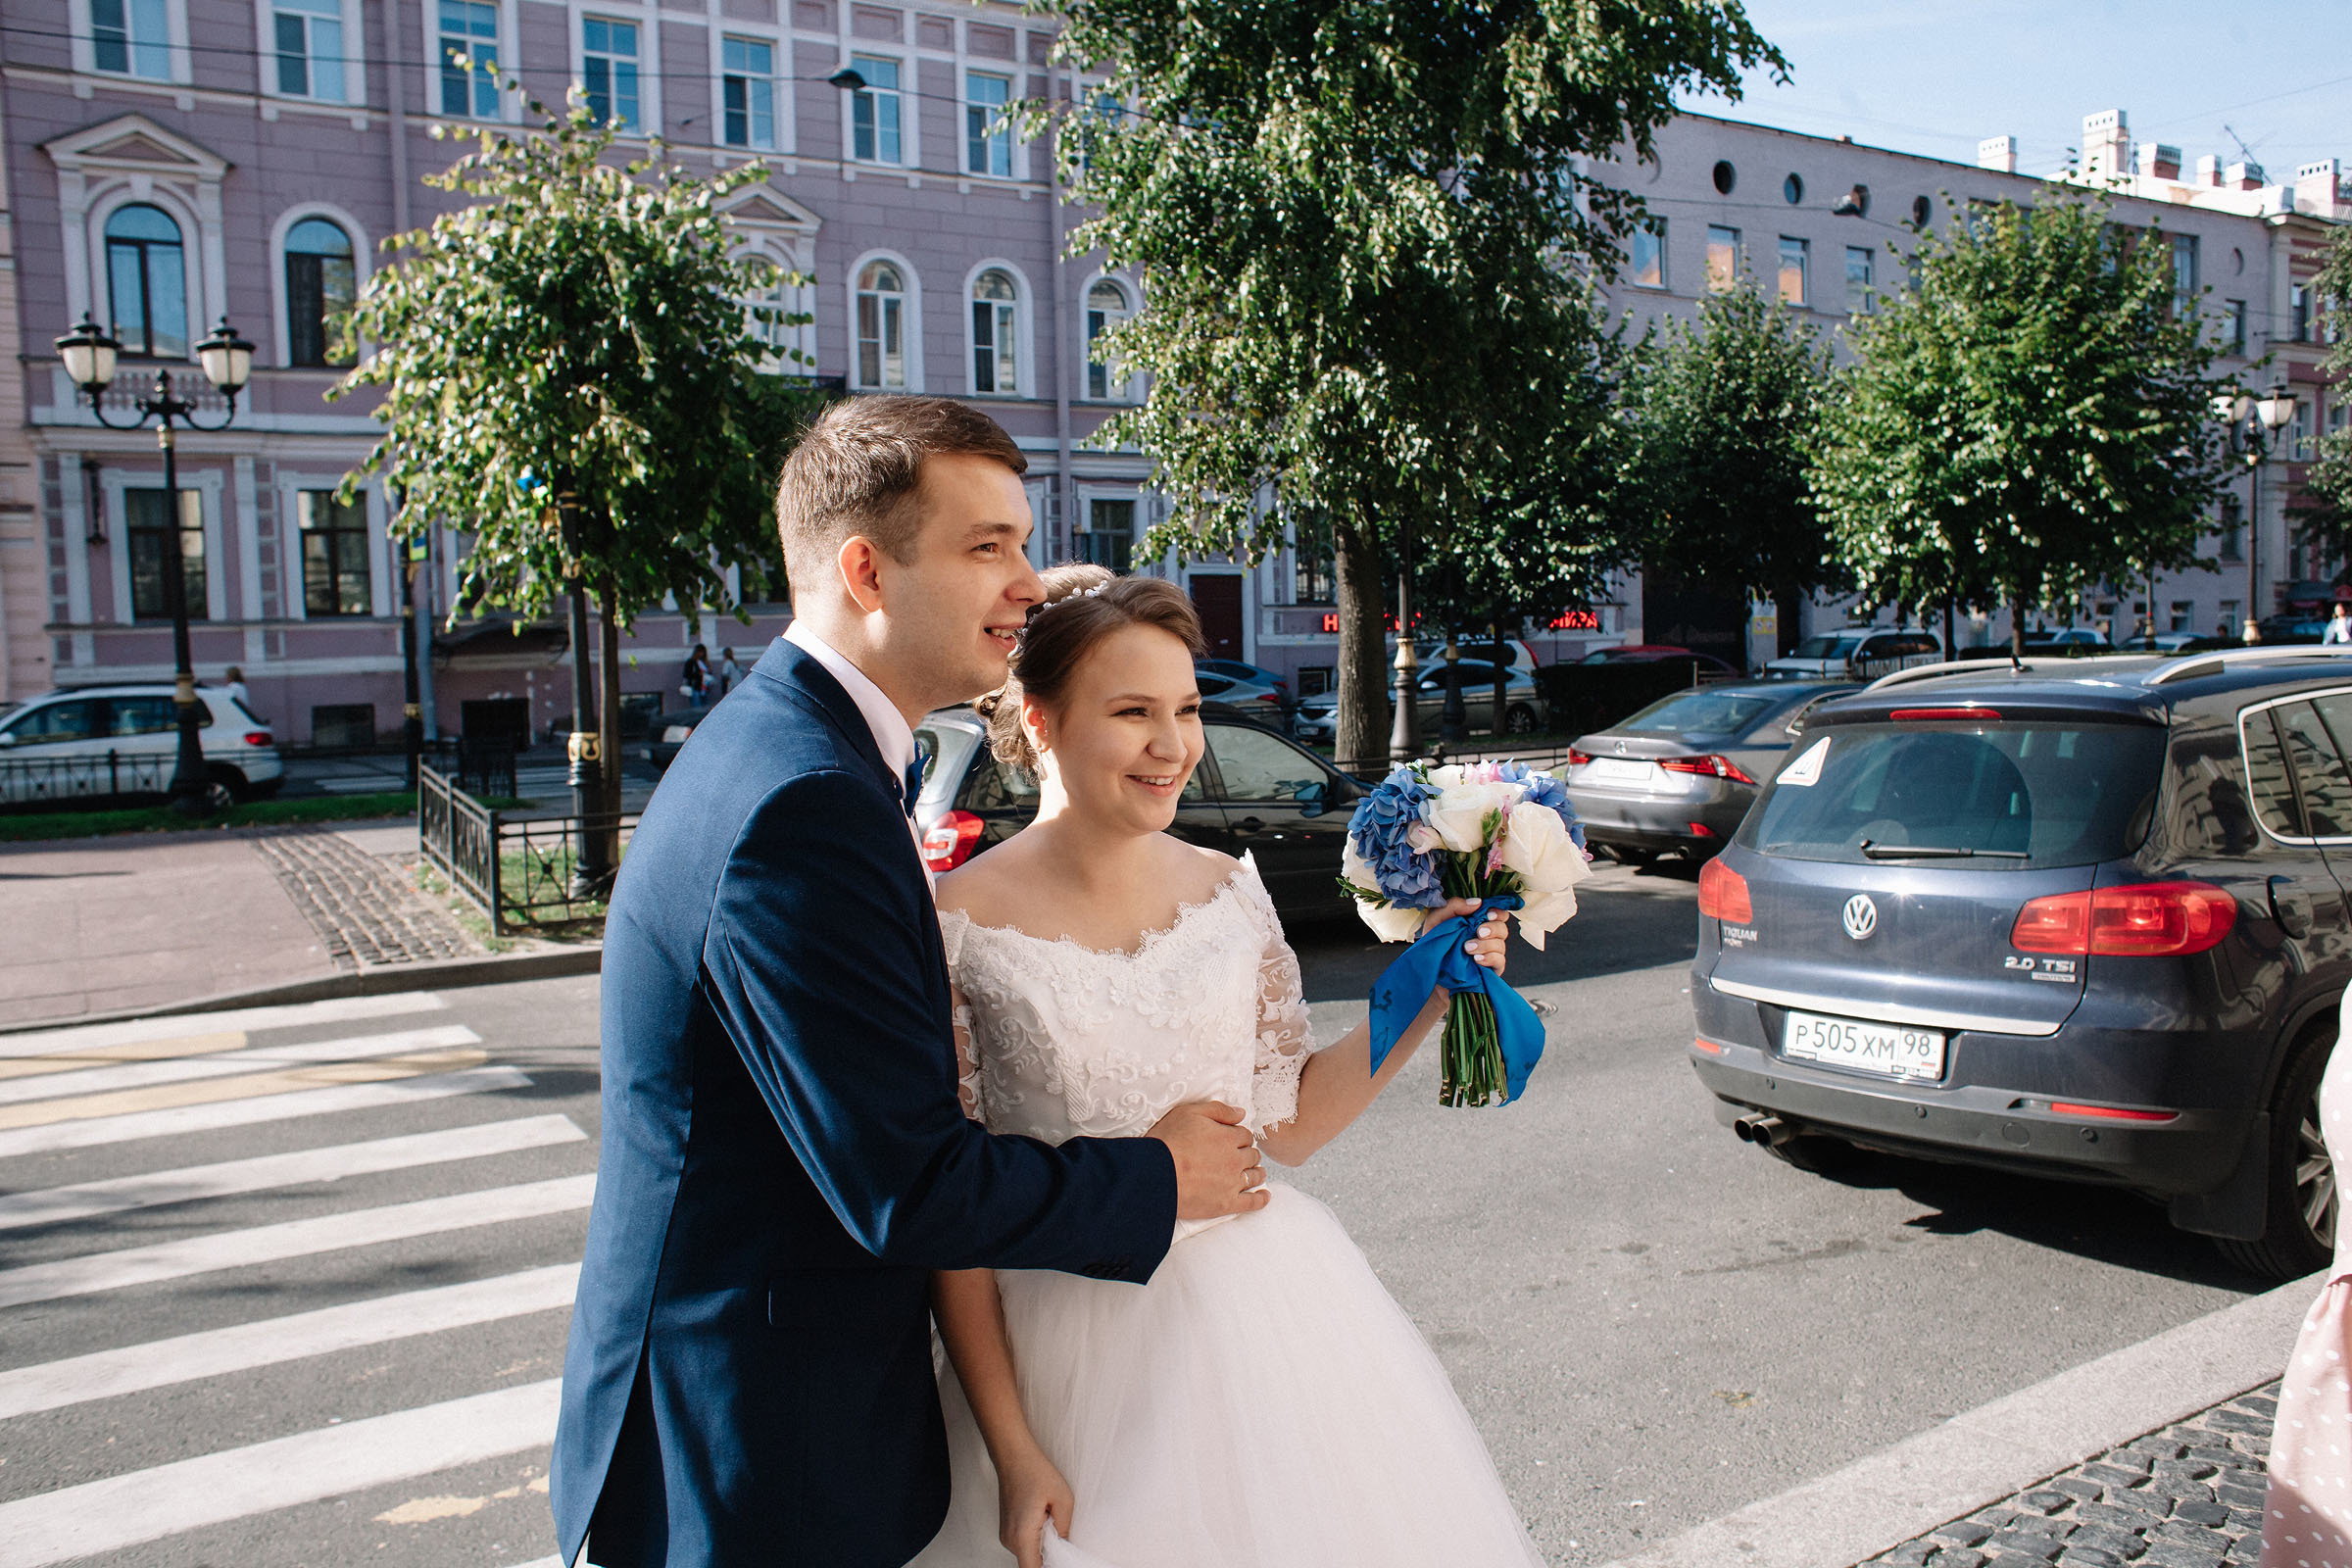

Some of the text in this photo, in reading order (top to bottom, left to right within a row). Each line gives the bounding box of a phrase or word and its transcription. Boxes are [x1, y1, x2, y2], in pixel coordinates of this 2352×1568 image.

[2004, 956, 2077, 973] 2.0 TSI
[1904, 1033, 1931, 1056] 98
